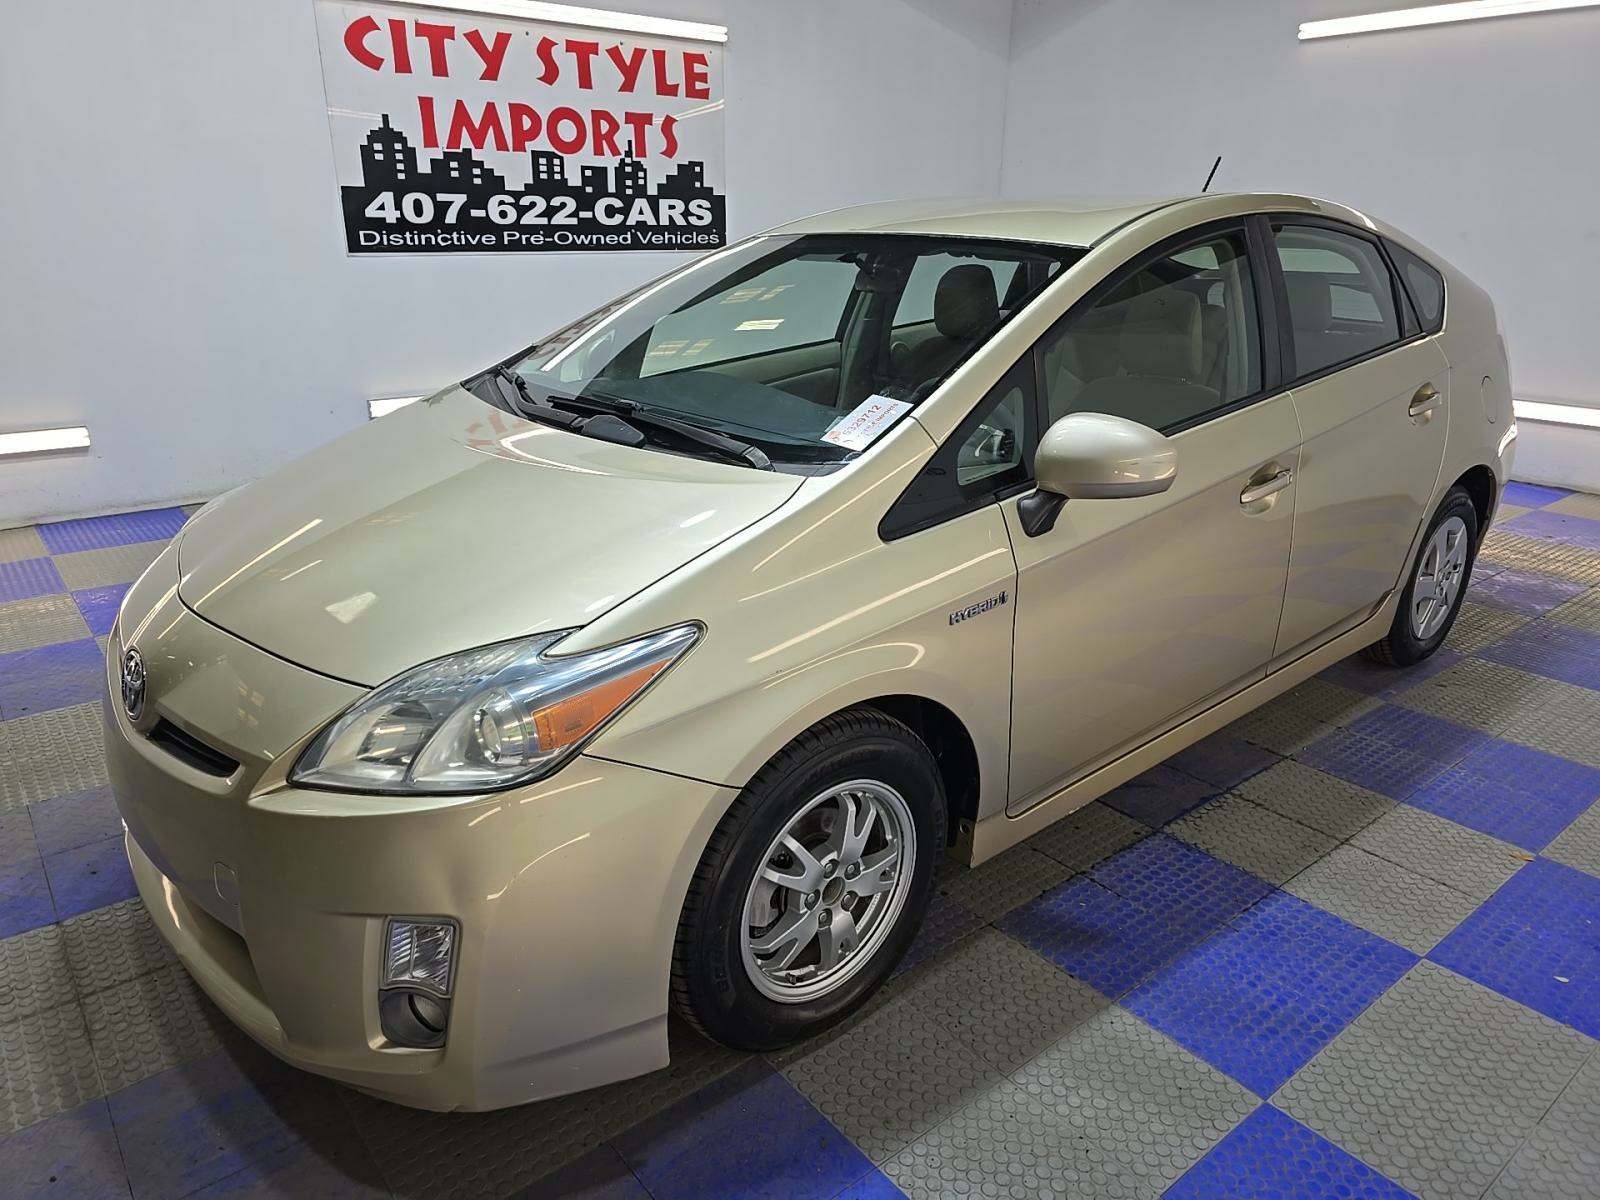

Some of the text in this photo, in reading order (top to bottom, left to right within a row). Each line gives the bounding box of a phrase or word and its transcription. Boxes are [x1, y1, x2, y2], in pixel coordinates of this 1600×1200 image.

[344, 15, 710, 100] CITY STYLE
[417, 96, 678, 159] IMPORTS
[364, 191, 713, 226] 407-622-CARS
[358, 230, 720, 247] Distinctive Pre-Owned Vehicles
[949, 596, 998, 626] HYBRID
